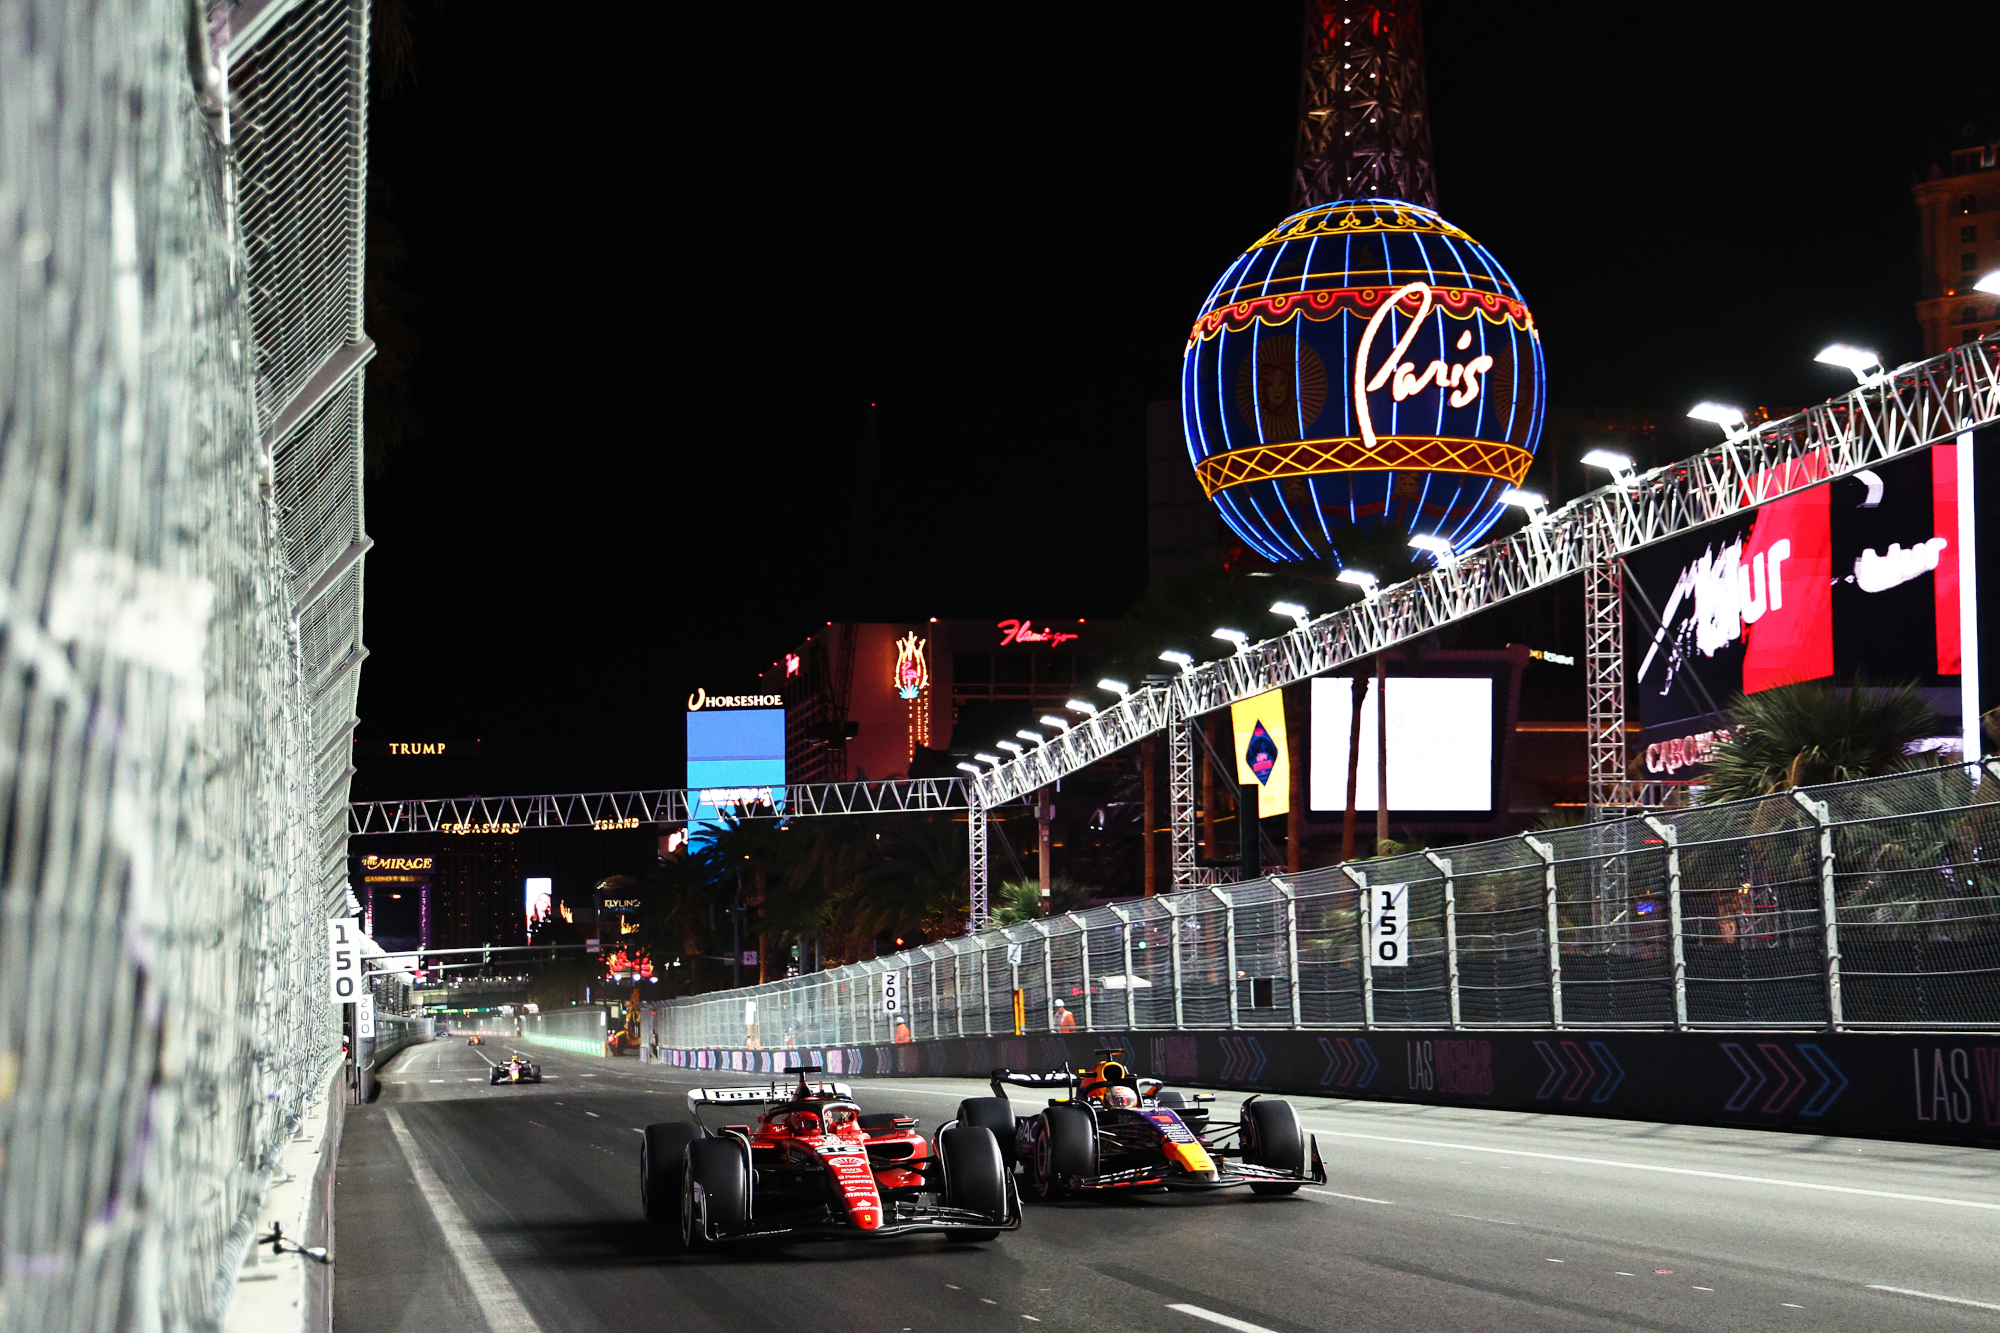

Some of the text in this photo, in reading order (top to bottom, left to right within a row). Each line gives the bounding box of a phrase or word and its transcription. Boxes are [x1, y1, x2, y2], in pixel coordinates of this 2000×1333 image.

[1354, 281, 1493, 448] Paris
[996, 619, 1079, 648] Flamingo
[705, 694, 783, 708] HORSESHOE
[389, 742, 446, 755] TRUMP
[441, 817, 640, 836] TREASURE ISLAND
[367, 857, 433, 871] MIRAGE
[1379, 890, 1398, 961] 150
[335, 924, 354, 997] 150
[886, 974, 896, 1011] 200
[360, 998, 370, 1034] 200
[1407, 1040, 1434, 1091] LAS
[1913, 1047, 1972, 1124] LAS
